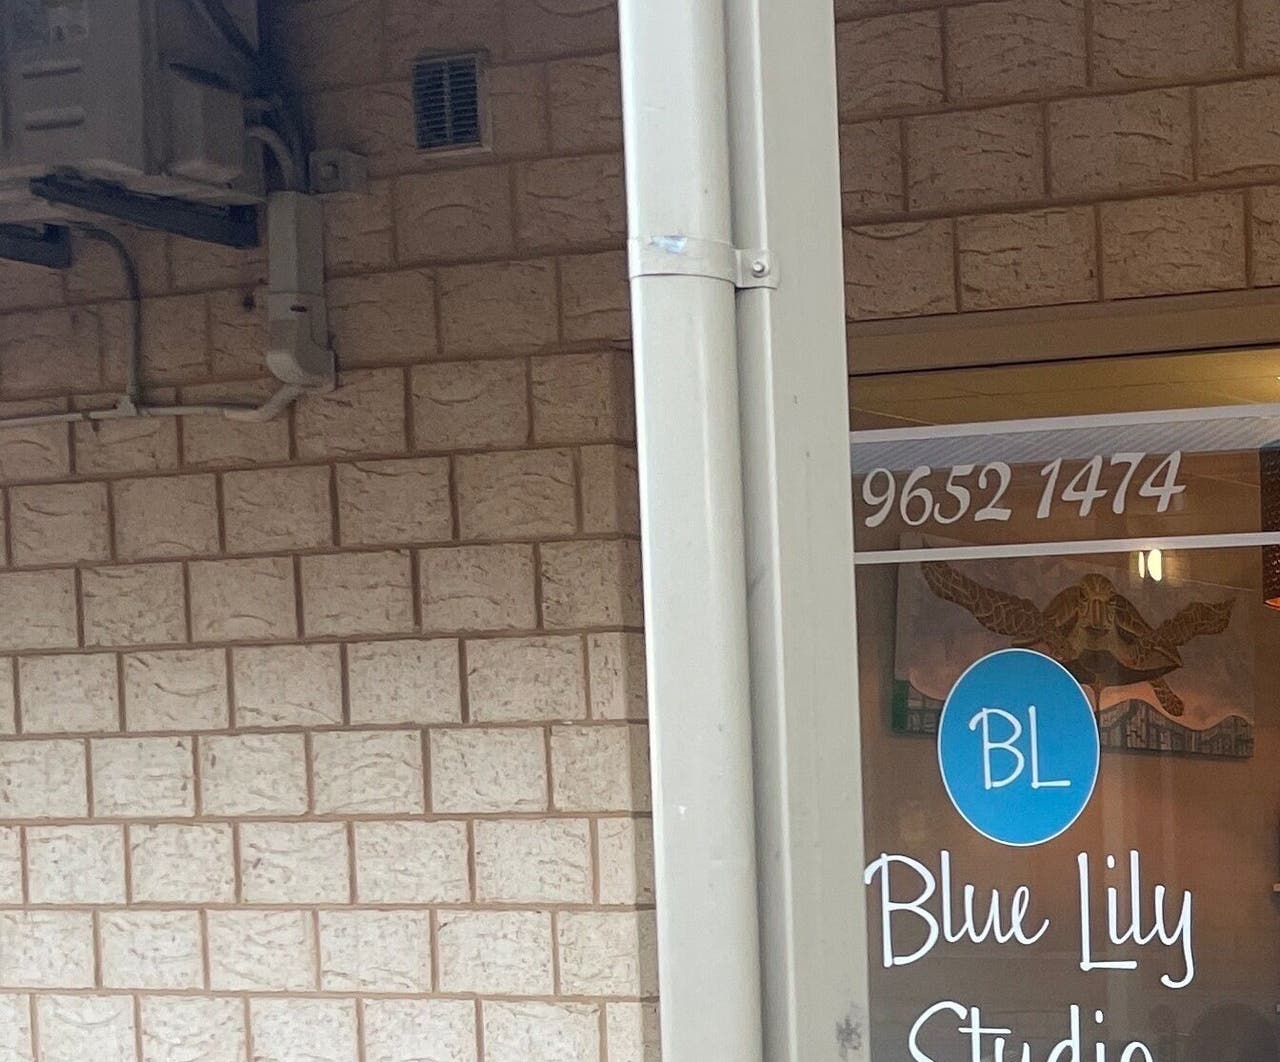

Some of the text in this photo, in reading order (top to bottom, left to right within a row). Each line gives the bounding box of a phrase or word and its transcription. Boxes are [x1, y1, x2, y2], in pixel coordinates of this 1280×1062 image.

[862, 450, 1187, 529] 9652 1474
[968, 705, 1072, 791] BL
[864, 850, 1195, 989] Blue Lily
